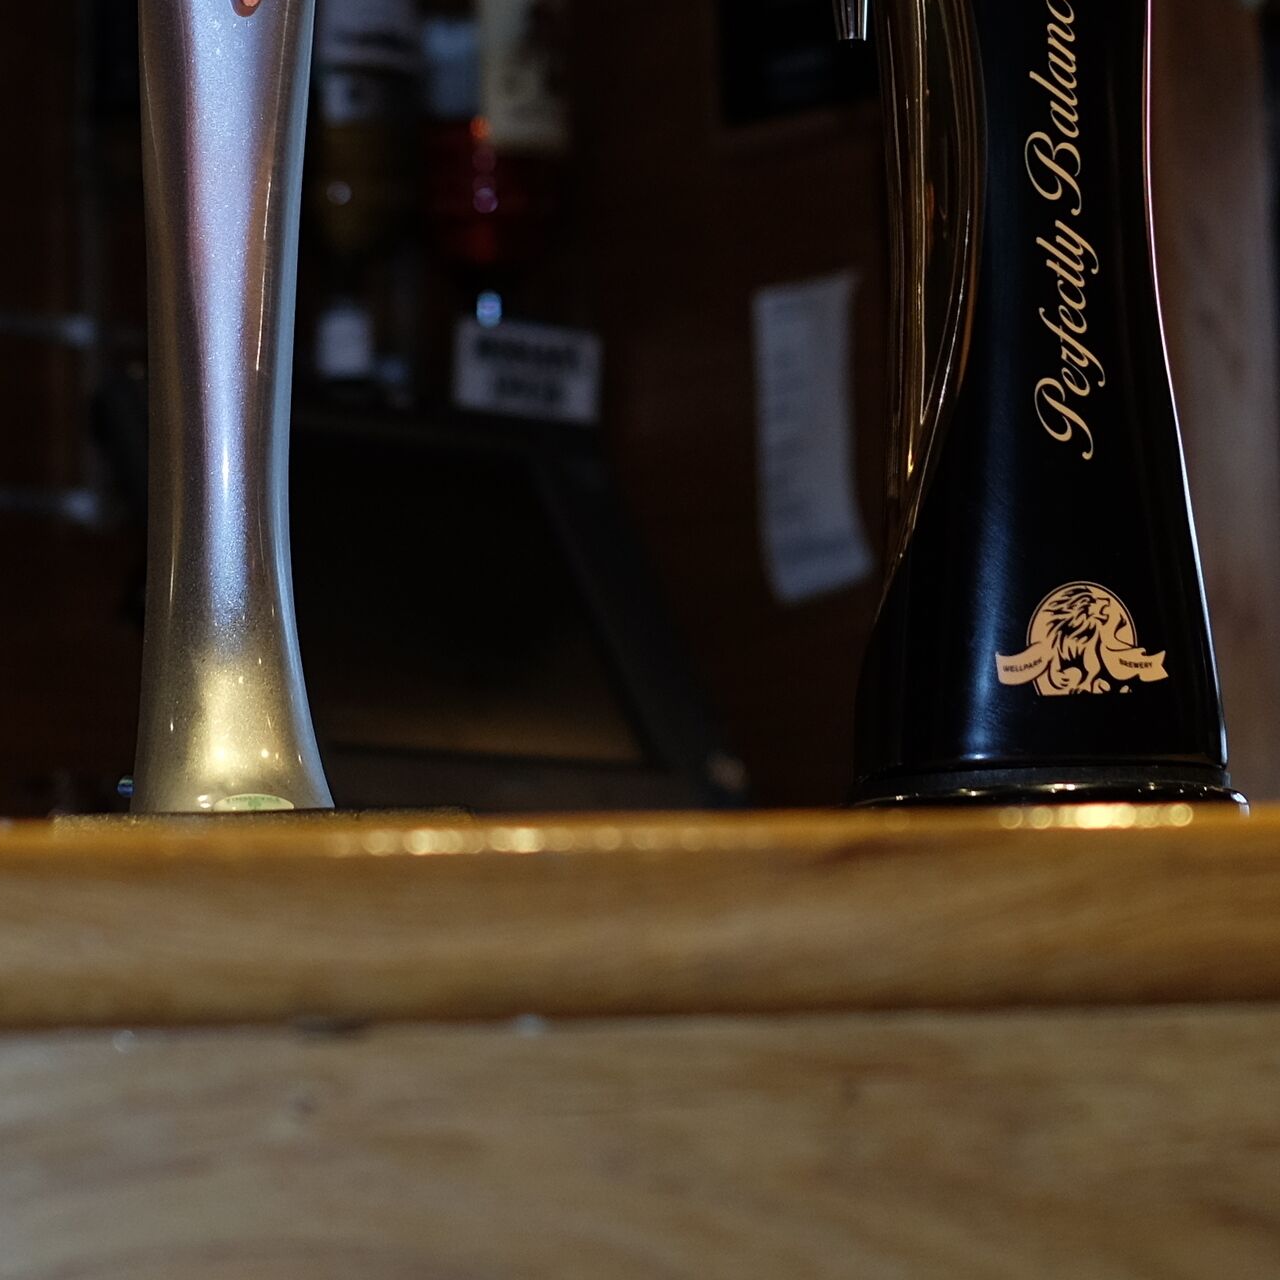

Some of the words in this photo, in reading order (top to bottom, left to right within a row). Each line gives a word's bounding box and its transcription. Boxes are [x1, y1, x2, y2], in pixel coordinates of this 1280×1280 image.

[1034, 219, 1106, 461] Perfectly
[1002, 658, 1043, 673] WELLPARK
[1119, 657, 1153, 669] BREWERY
